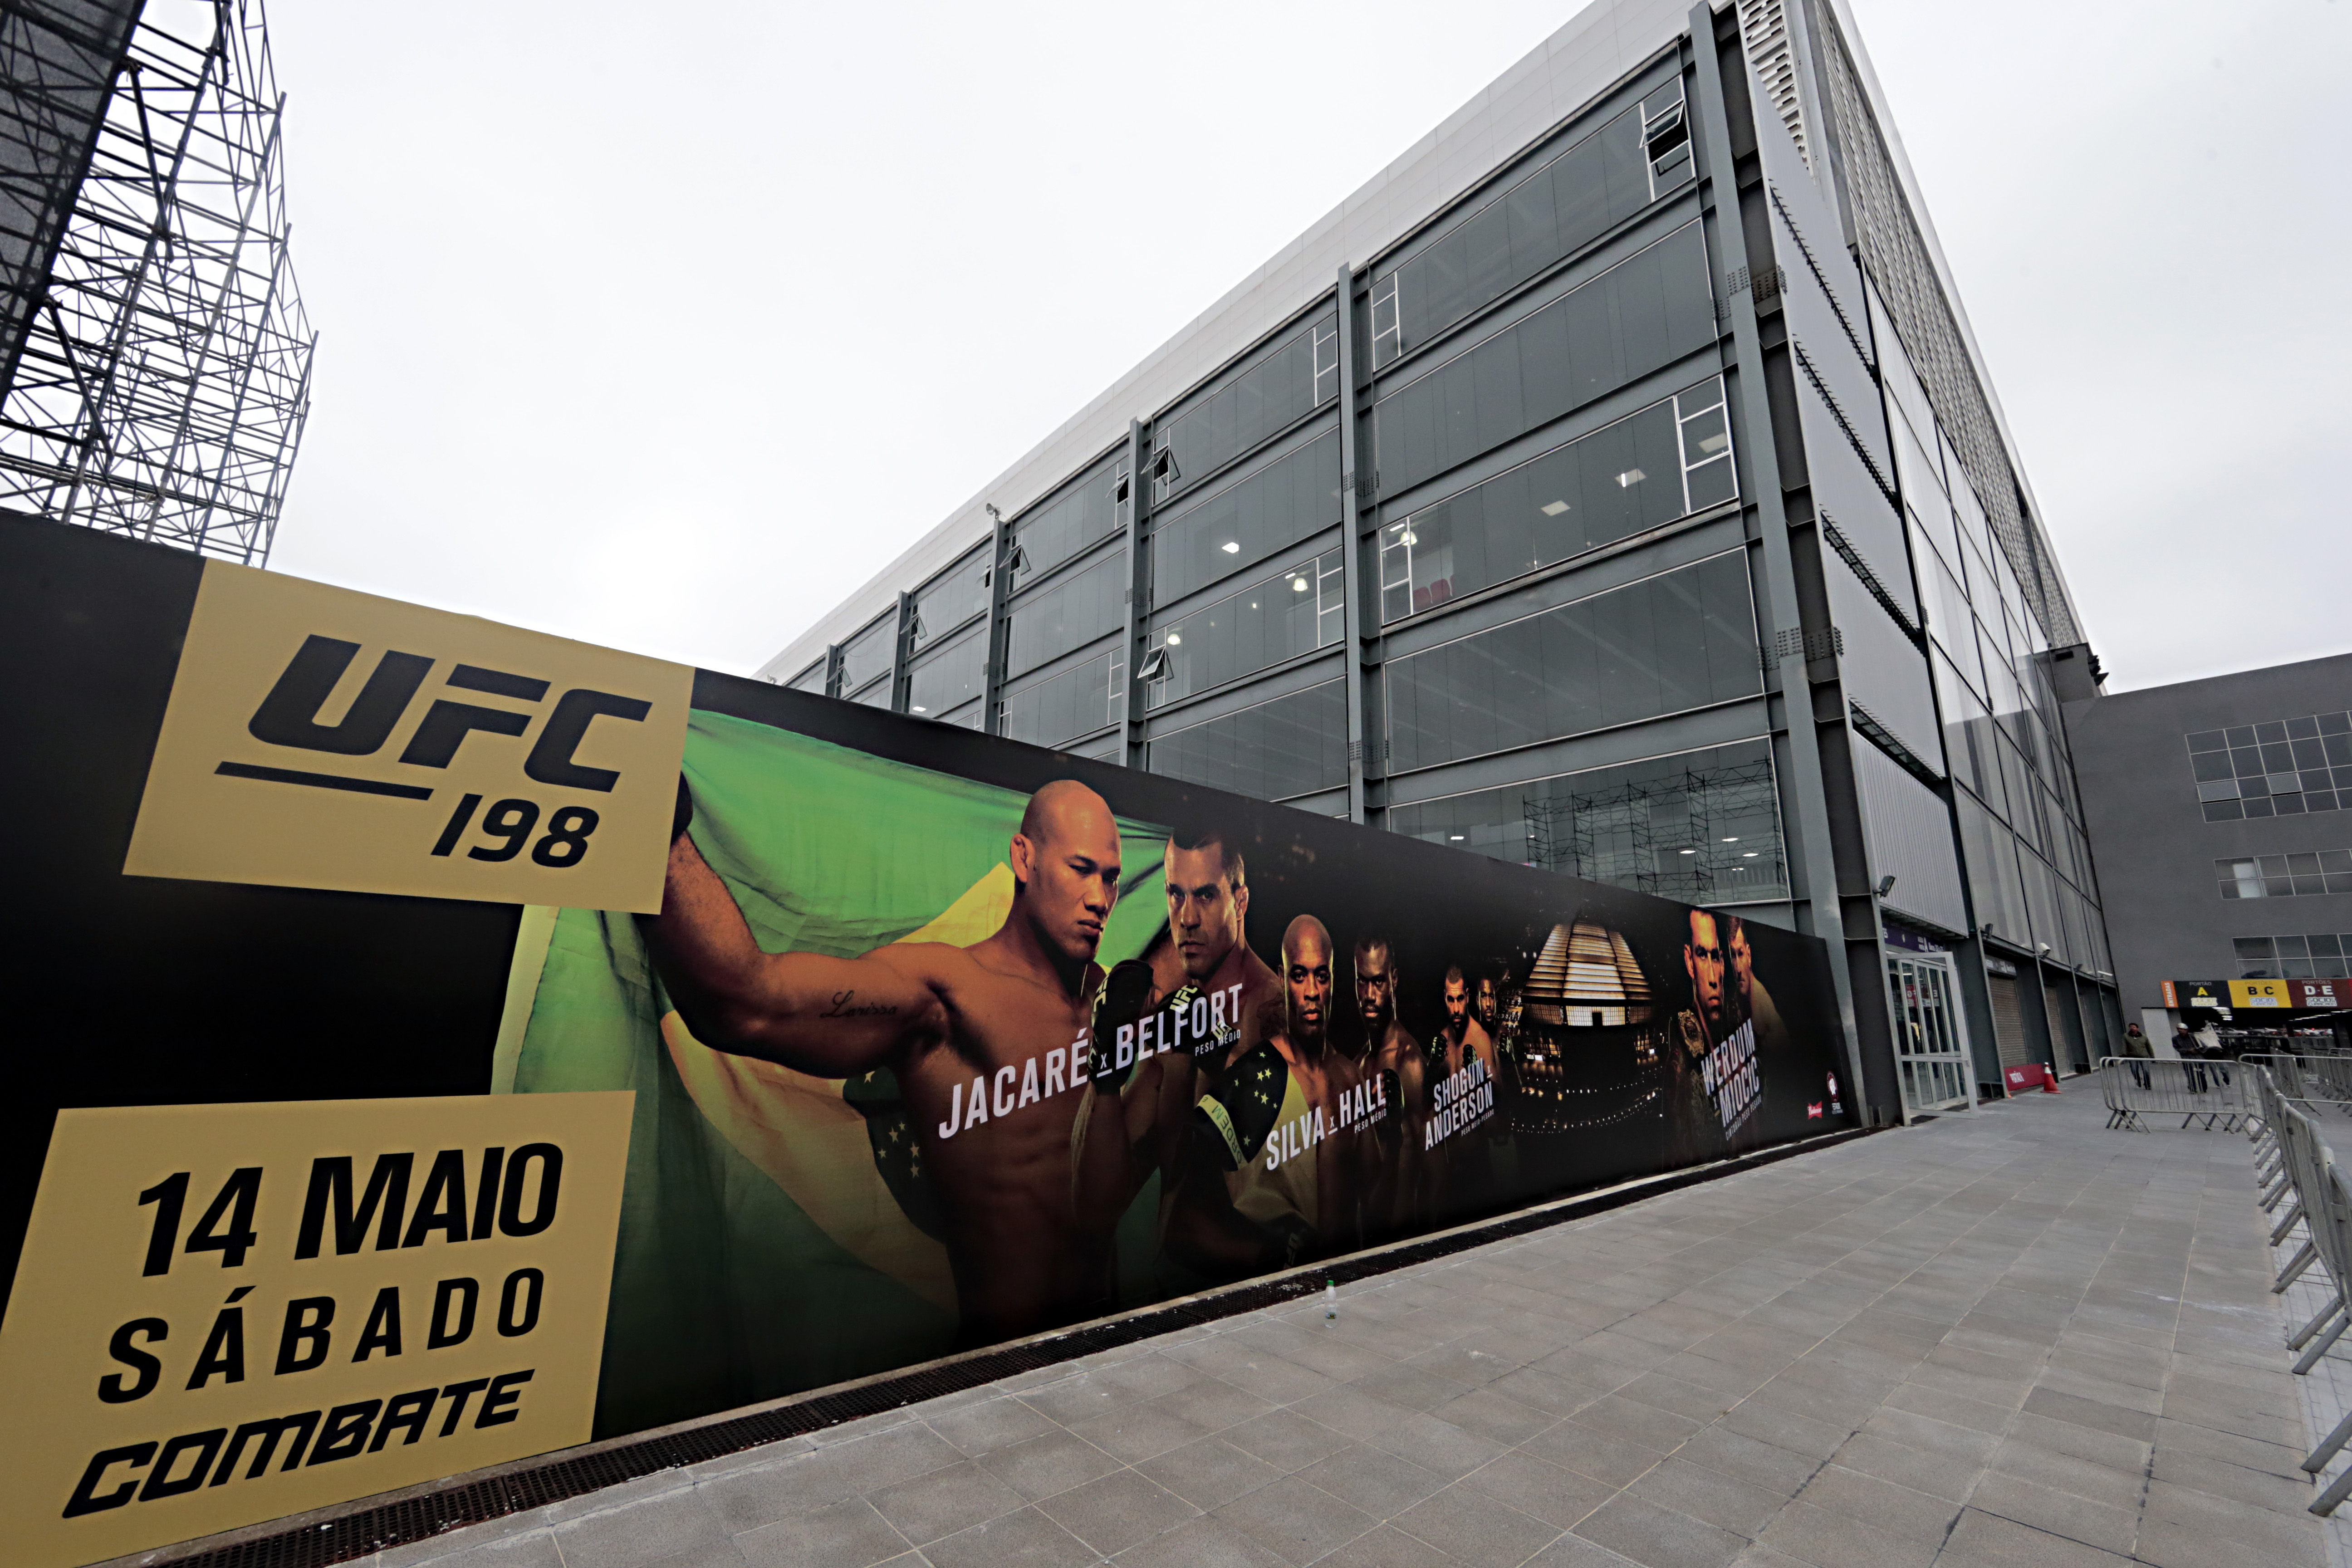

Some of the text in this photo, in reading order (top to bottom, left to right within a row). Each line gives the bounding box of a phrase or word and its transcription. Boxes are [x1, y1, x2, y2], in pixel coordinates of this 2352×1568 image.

[248, 634, 652, 793] UFC
[431, 793, 599, 867] 198
[1169, 985, 1198, 1014] UFC
[2164, 982, 2175, 1006] ENTRADAS
[2197, 987, 2208, 996] A
[939, 1027, 1088, 1139] JACARÉ
[1116, 983, 1242, 1070] BELFORT
[1196, 1040, 1214, 1056] PESO
[1701, 1018, 1755, 1096] WERDUM
[1426, 1081, 1493, 1151] ANDERSON
[1434, 1058, 1484, 1112] SHOGUN
[1719, 1056, 1759, 1127] MIOCIC
[1725, 1094, 1761, 1141] CINTURÃO PESO PESADO
[1212, 1105, 1242, 1164] ORDEM
[1266, 1106, 1325, 1170] SILVA
[1340, 1073, 1386, 1128] HALL
[1355, 1108, 1387, 1133] PESO MÉDIO
[1461, 1125, 1470, 1136] PESO
[138, 1142, 563, 1277] 14 MAIO
[98, 1268, 544, 1404] SÁBADO
[62, 1369, 535, 1518] COMBATE
